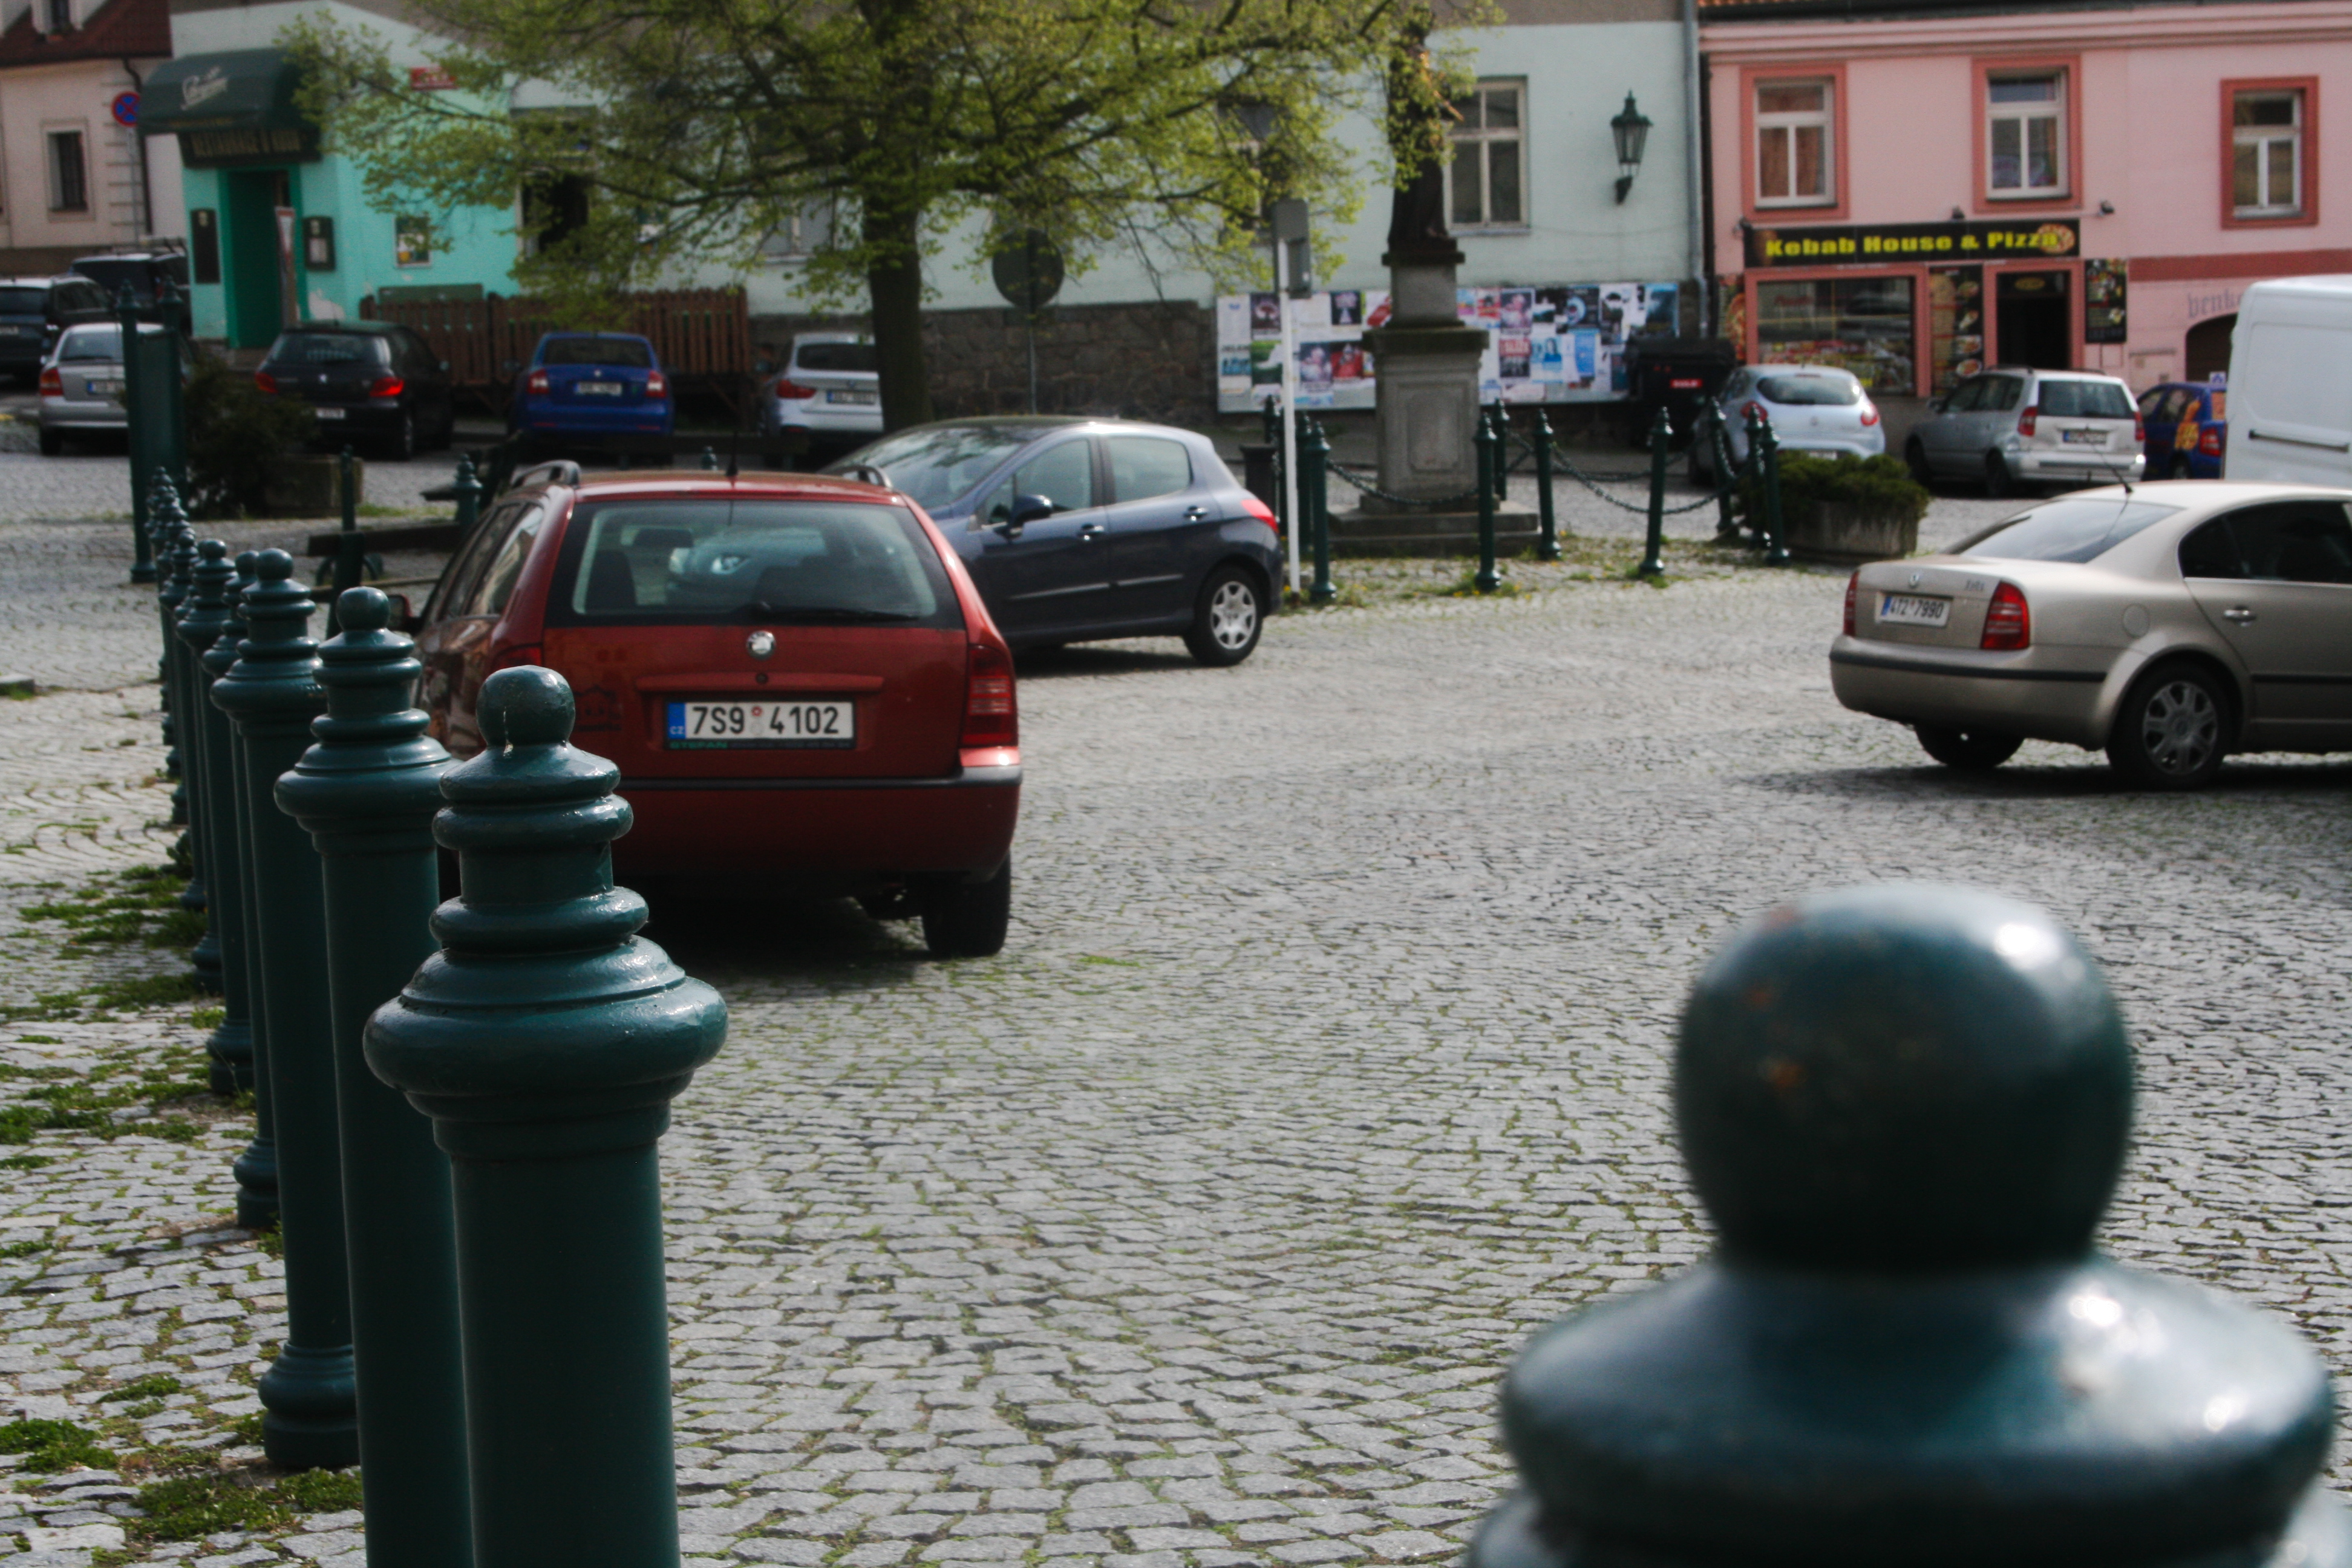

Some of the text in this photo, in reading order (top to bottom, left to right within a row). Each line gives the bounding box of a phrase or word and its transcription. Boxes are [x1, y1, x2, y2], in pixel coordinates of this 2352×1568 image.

[1765, 231, 2058, 256] Kebab House & Pizza
[1914, 599, 1944, 618] 7990
[670, 726, 685, 734] CZ
[693, 706, 838, 734] 7S9 4102
